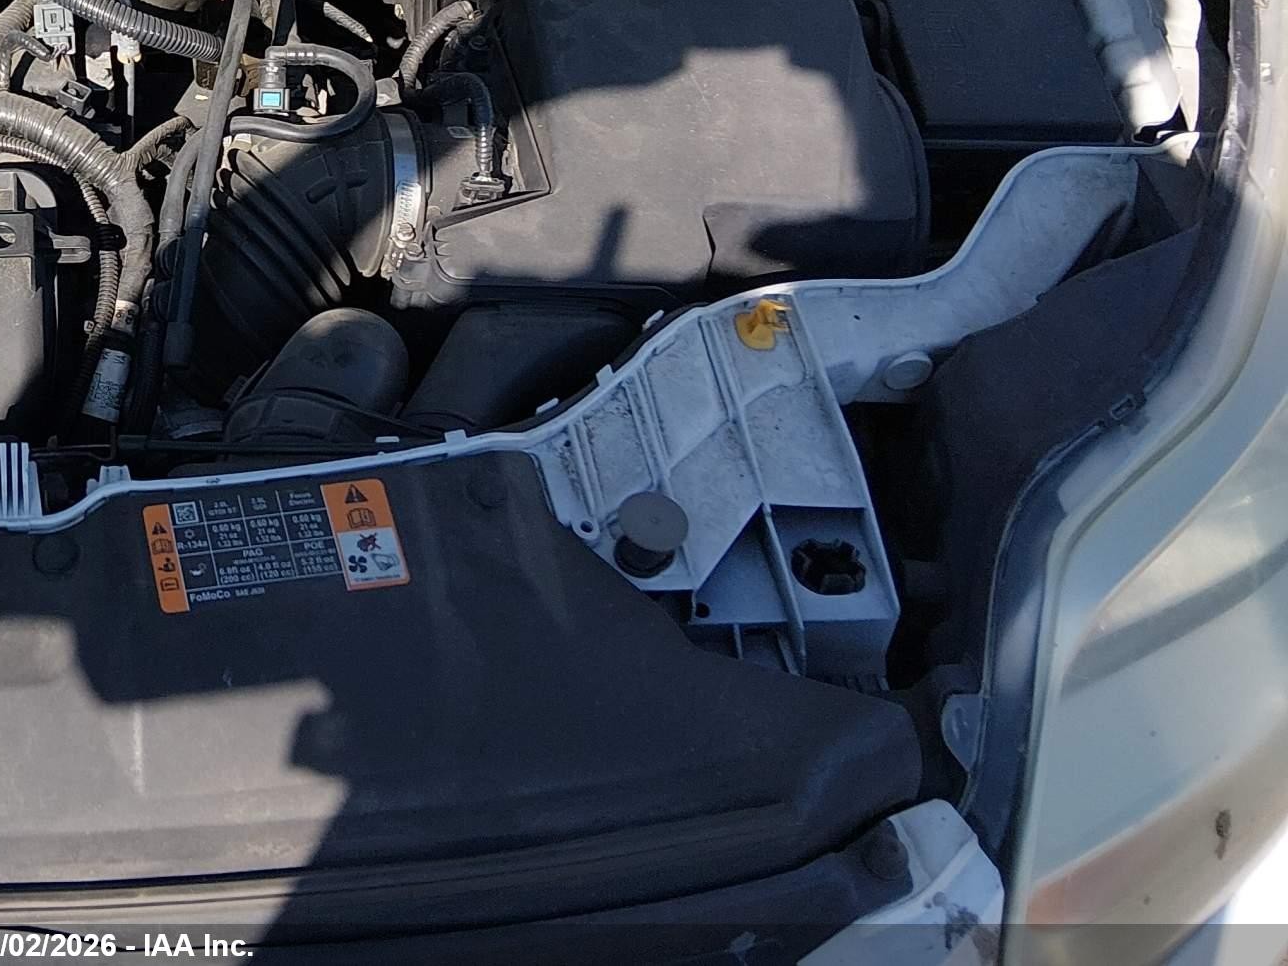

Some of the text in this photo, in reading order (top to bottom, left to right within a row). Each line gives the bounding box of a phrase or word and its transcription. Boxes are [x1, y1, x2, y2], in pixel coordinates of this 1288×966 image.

[176, 540, 208, 551] R-134a
[242, 547, 264, 558] PAG
[189, 589, 231, 603] FoMoCo
